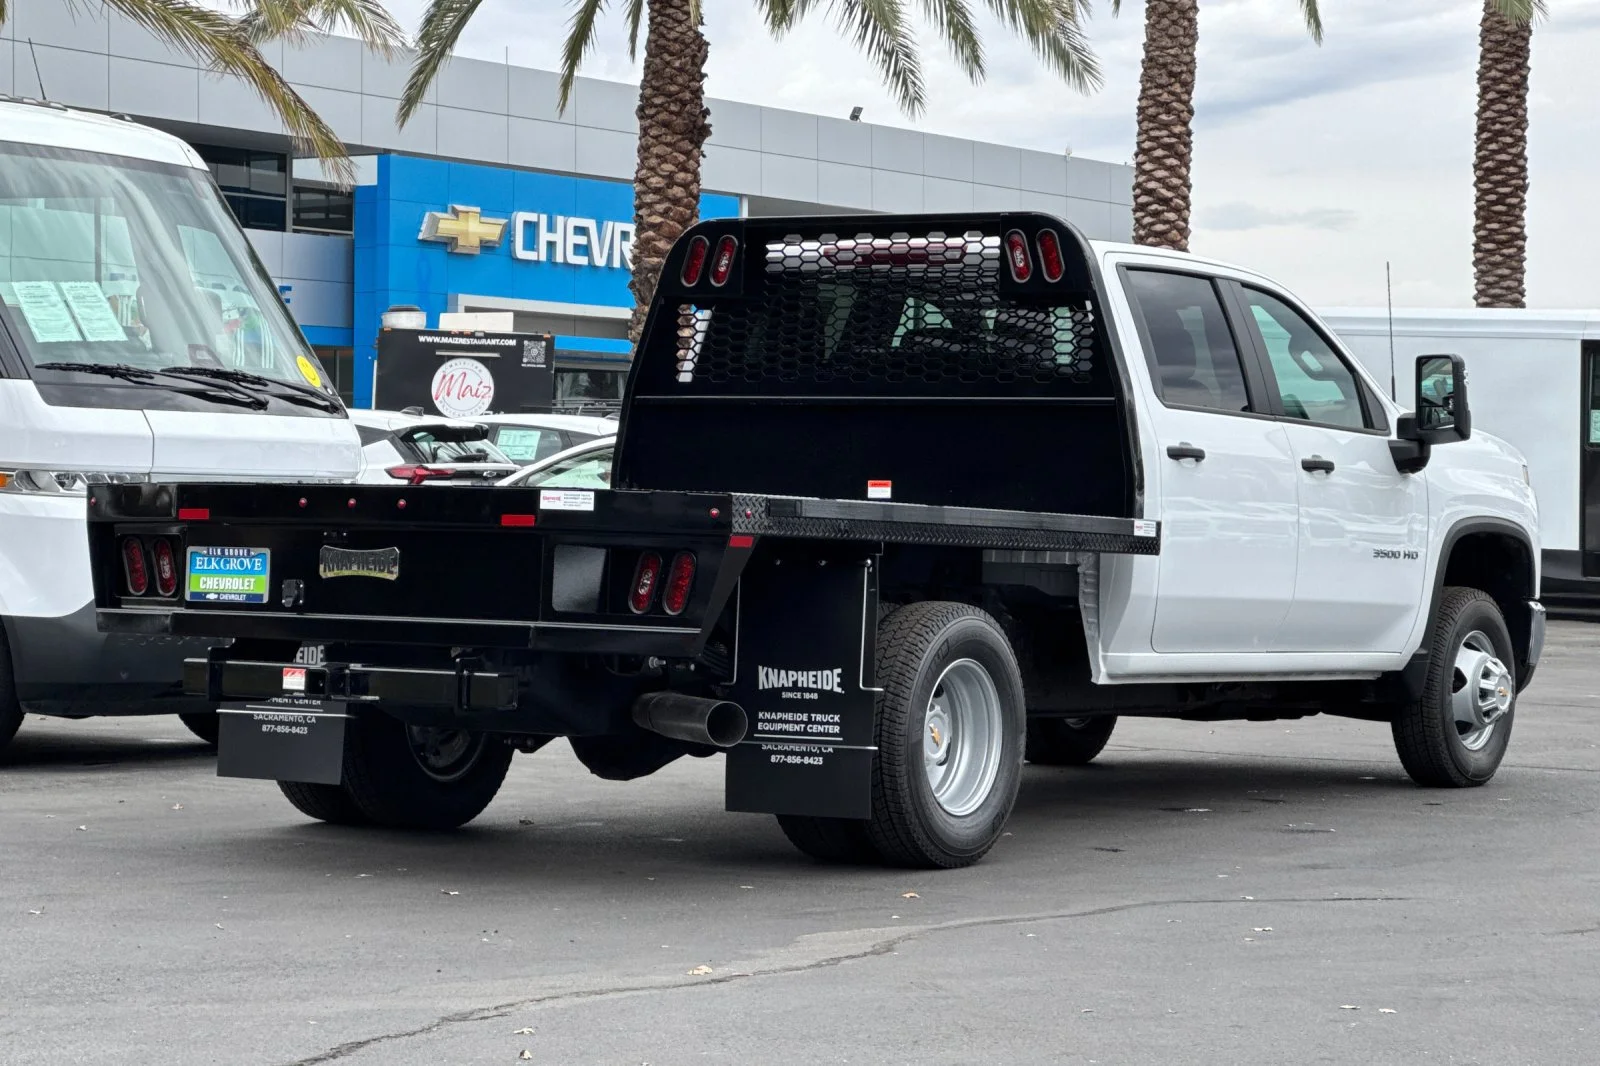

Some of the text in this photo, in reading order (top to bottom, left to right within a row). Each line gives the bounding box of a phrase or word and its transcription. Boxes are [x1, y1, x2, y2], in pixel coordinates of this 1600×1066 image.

[418, 335, 517, 346] WWW.MAIZRESTAURANT.COM
[434, 371, 492, 401] Maiz
[1372, 549, 1419, 560] 3500 HD
[195, 556, 262, 571] ELK GROVE
[200, 576, 256, 590] CHEVROLET
[219, 593, 246, 601] CHEVROLET
[758, 665, 843, 694] KNAPHEIDE
[781, 691, 818, 700] SINCE 1848
[253, 713, 317, 724] SACRAMENTO, CA
[758, 711, 840, 722] KNAPHEIDE TRUCK
[261, 724, 308, 734] 877-856-8423
[757, 722, 840, 734] EQUIPMENT CENTER
[770, 754, 823, 765] 877-856-8423
